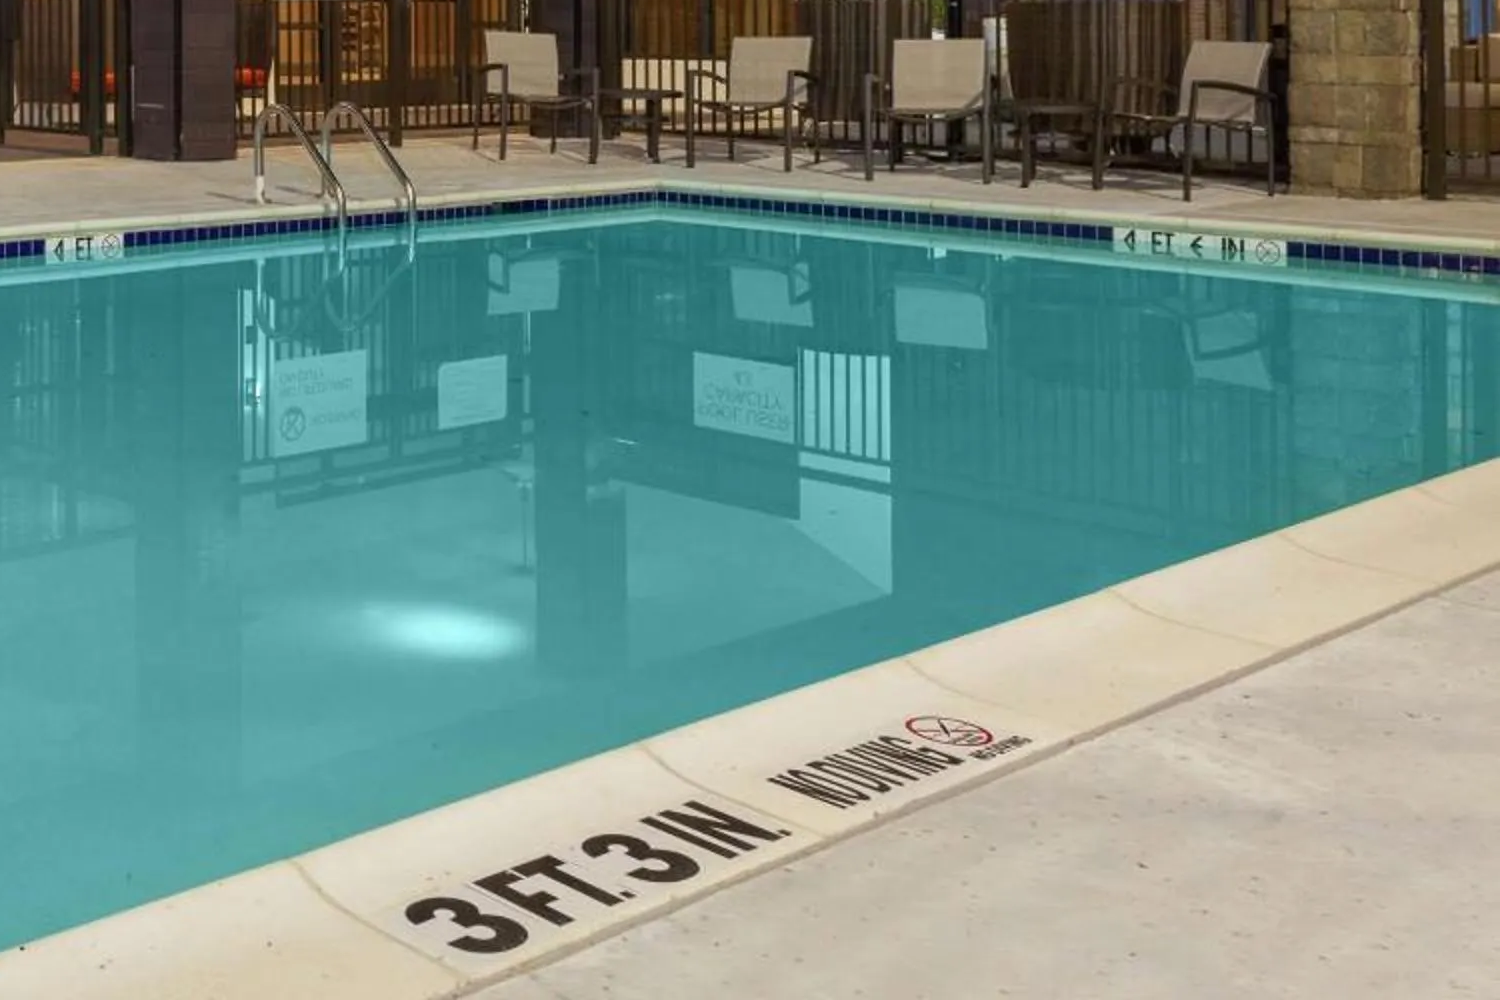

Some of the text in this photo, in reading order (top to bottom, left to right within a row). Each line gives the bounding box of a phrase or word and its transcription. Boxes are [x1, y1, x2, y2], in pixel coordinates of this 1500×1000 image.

[766, 736, 965, 809] NO DIVING
[404, 800, 792, 954] 3 FT. 3 IN.
